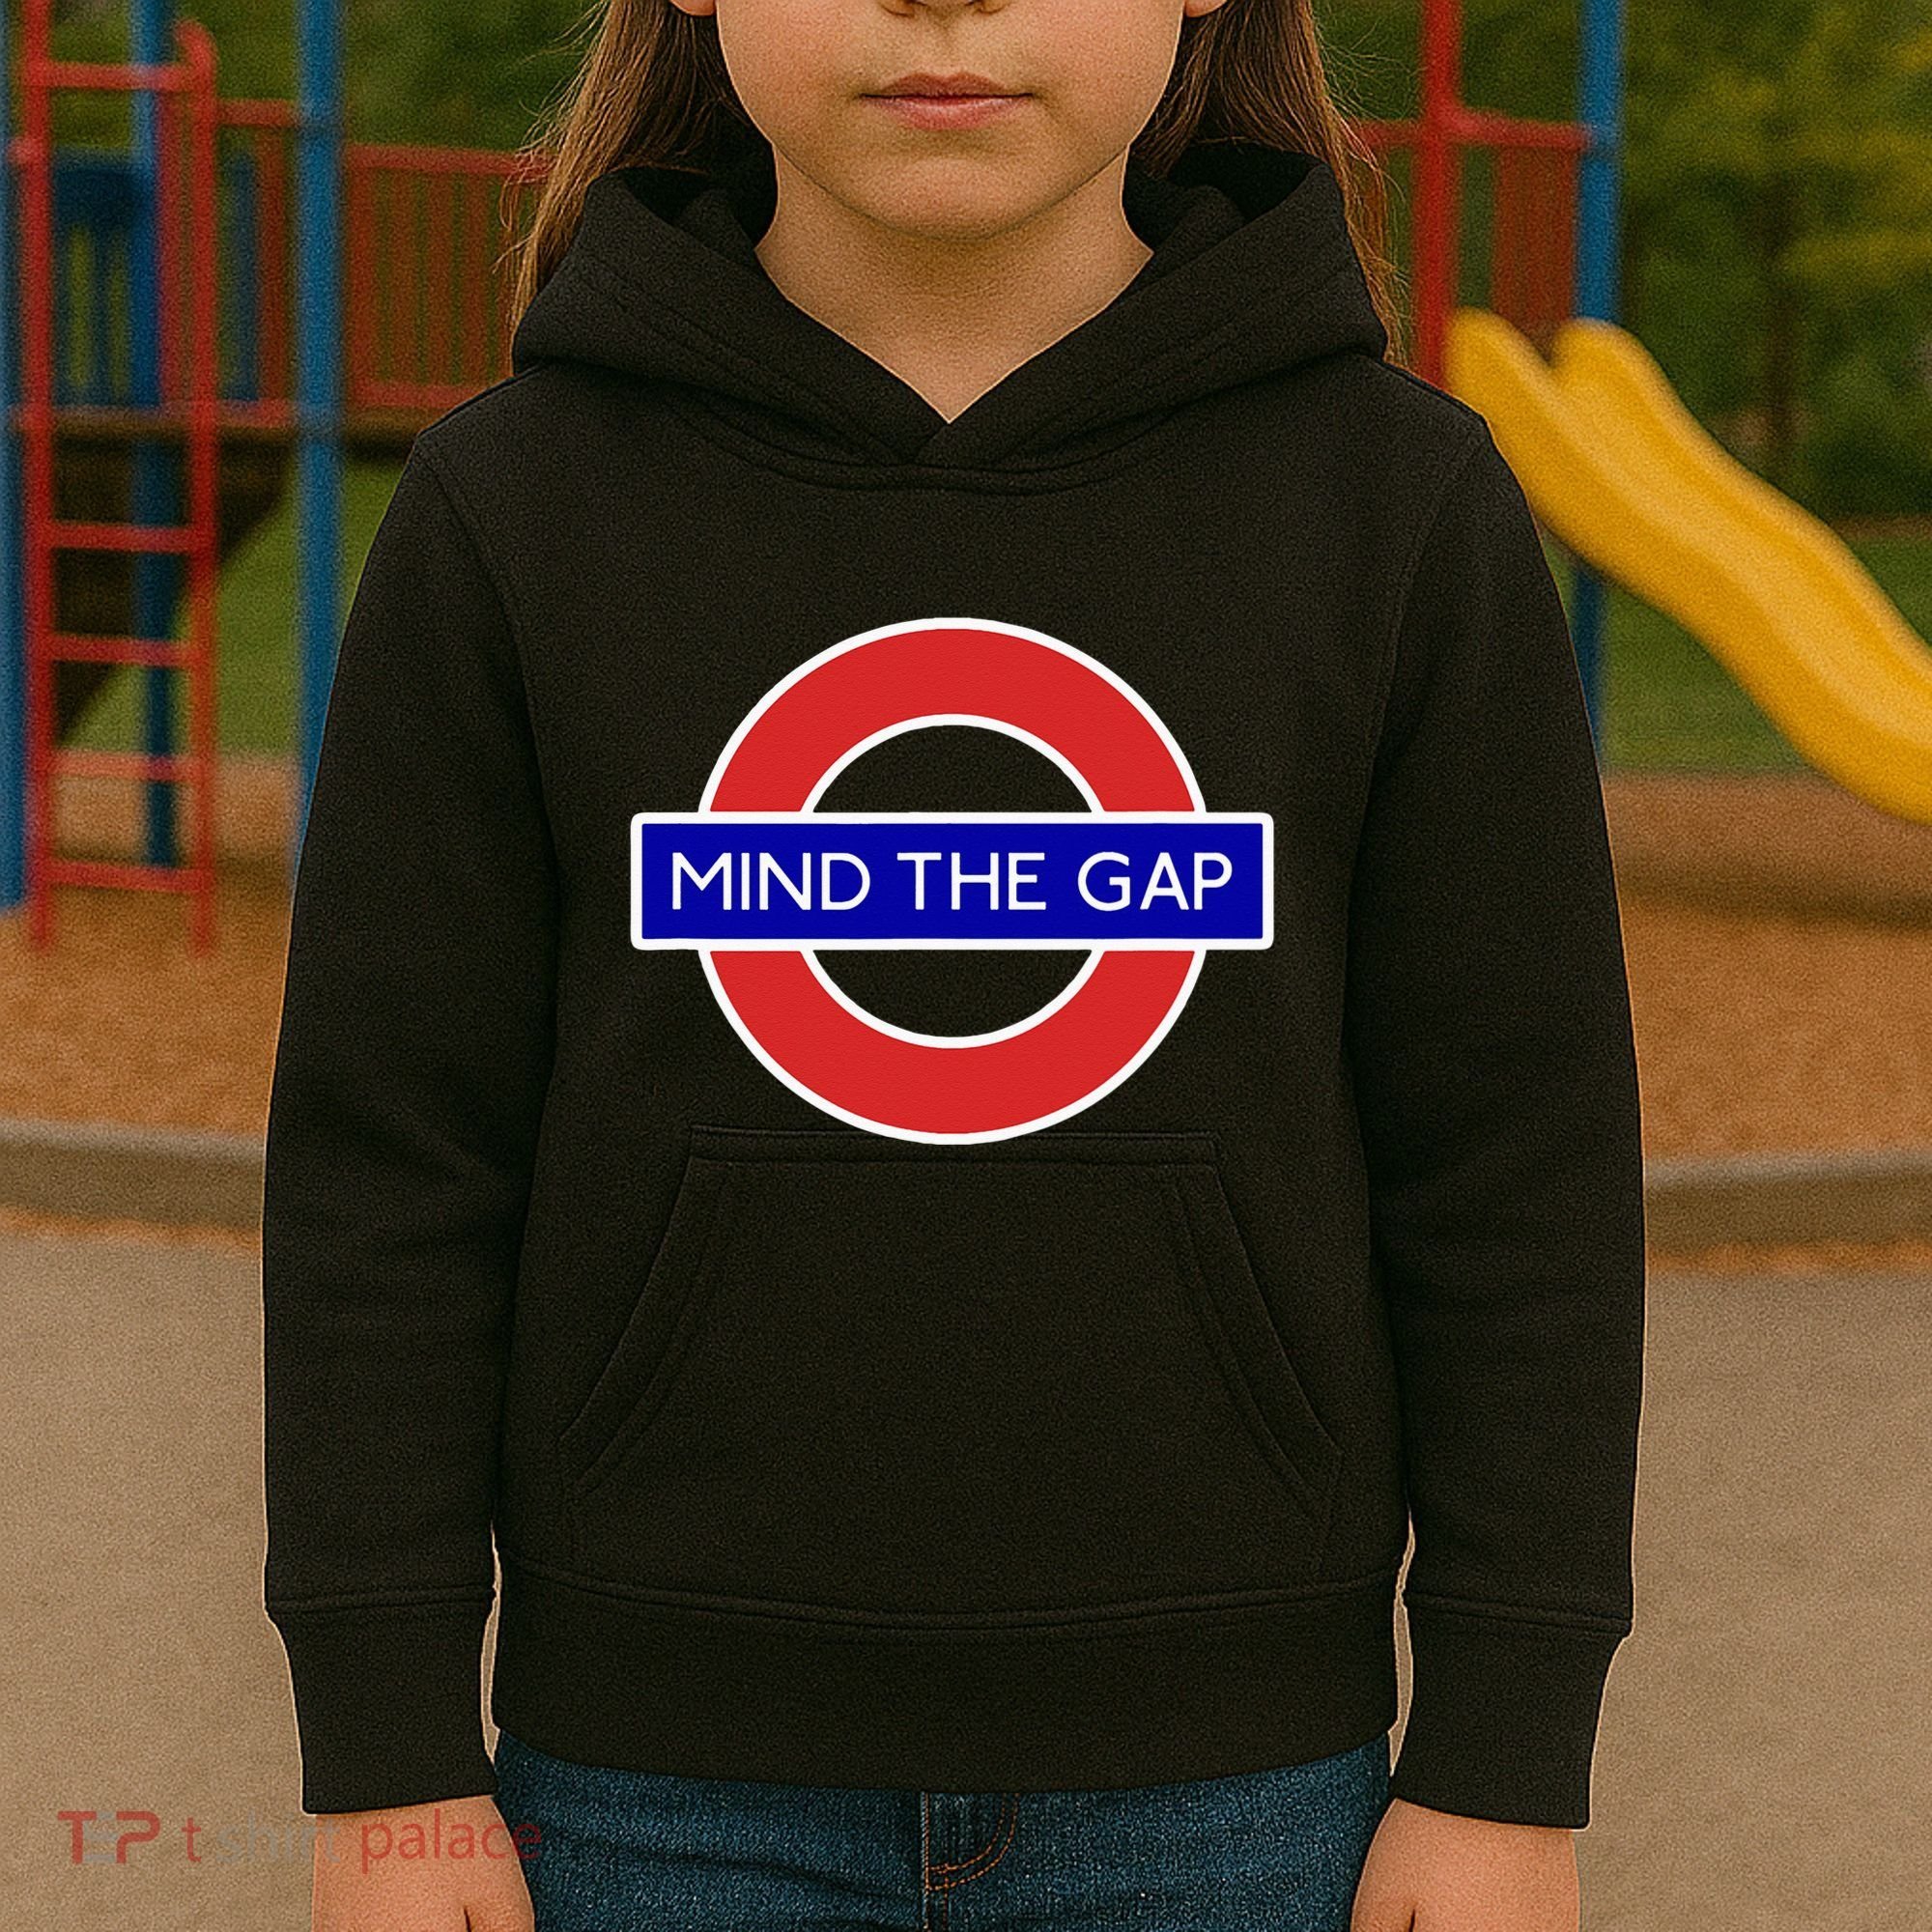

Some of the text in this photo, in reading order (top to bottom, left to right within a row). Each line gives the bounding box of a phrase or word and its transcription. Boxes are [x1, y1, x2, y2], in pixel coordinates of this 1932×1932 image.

[671, 851, 1233, 912] MIND THE GAP
